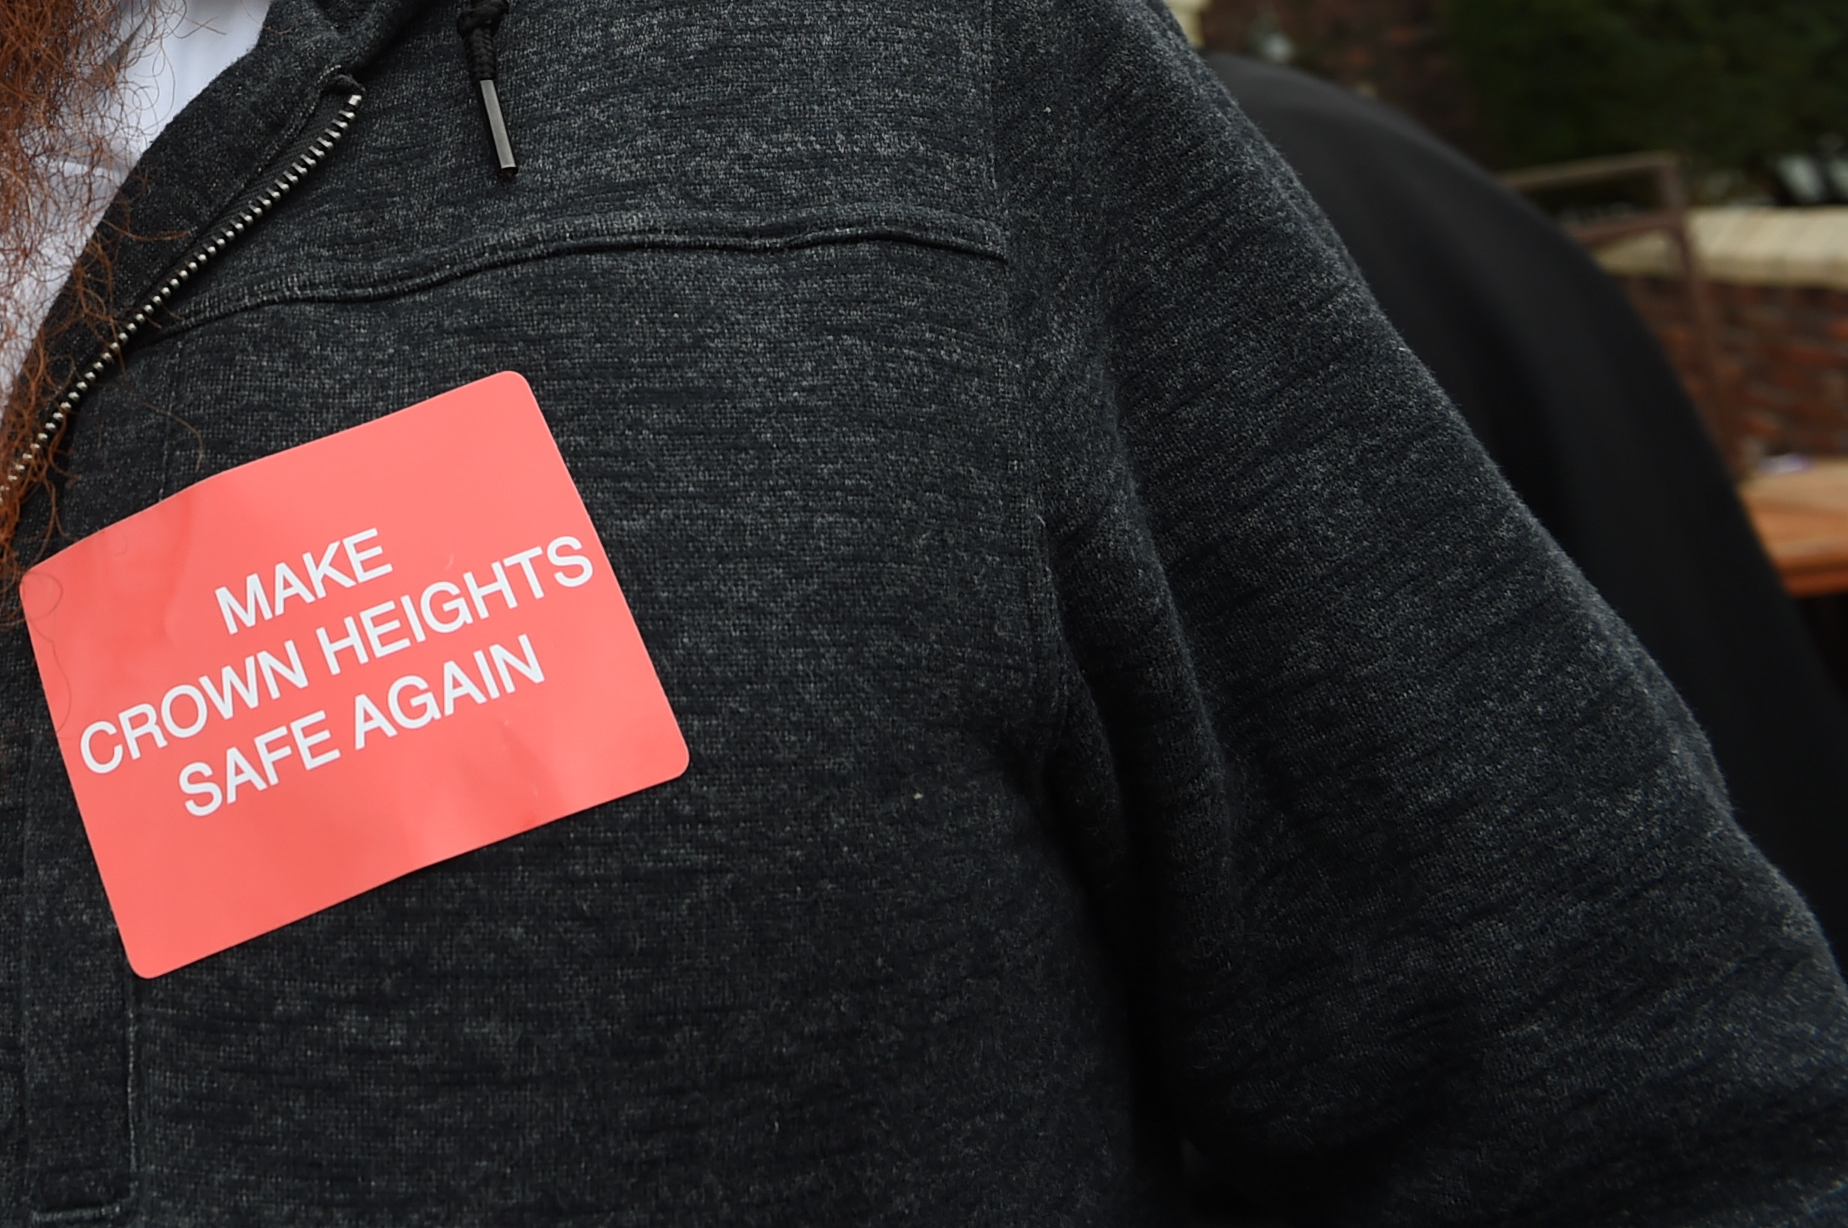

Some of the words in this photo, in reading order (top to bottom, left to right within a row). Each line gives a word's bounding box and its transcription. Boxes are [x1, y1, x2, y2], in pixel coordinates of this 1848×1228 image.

[79, 639, 310, 775] CROWN
[315, 535, 595, 676] HEIGHTS
[214, 526, 394, 636] MAKE
[177, 709, 342, 818] SAFE
[353, 633, 547, 751] AGAIN
